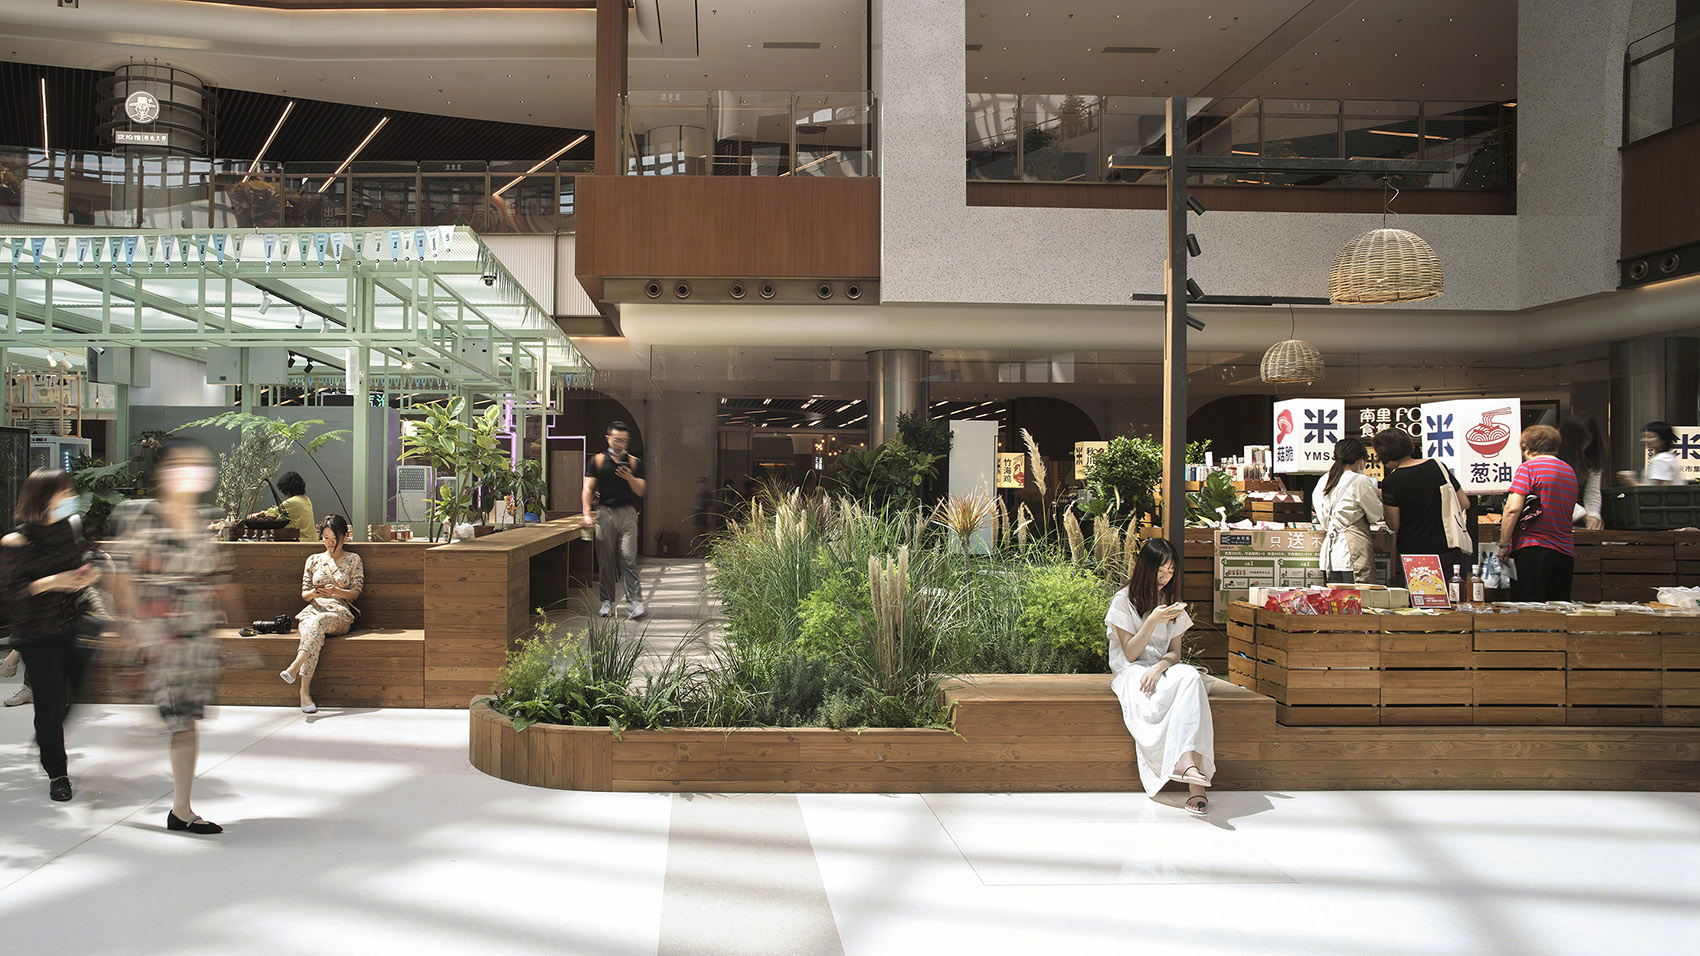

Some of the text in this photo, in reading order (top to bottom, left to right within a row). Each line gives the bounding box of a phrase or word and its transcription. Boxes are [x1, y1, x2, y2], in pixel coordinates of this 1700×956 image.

[1360, 407, 1392, 423] 南里
[1277, 446, 1294, 462] 菇脆
[1003, 458, 1012, 483] 竹海鸡
[1470, 461, 1512, 484] 葱油
